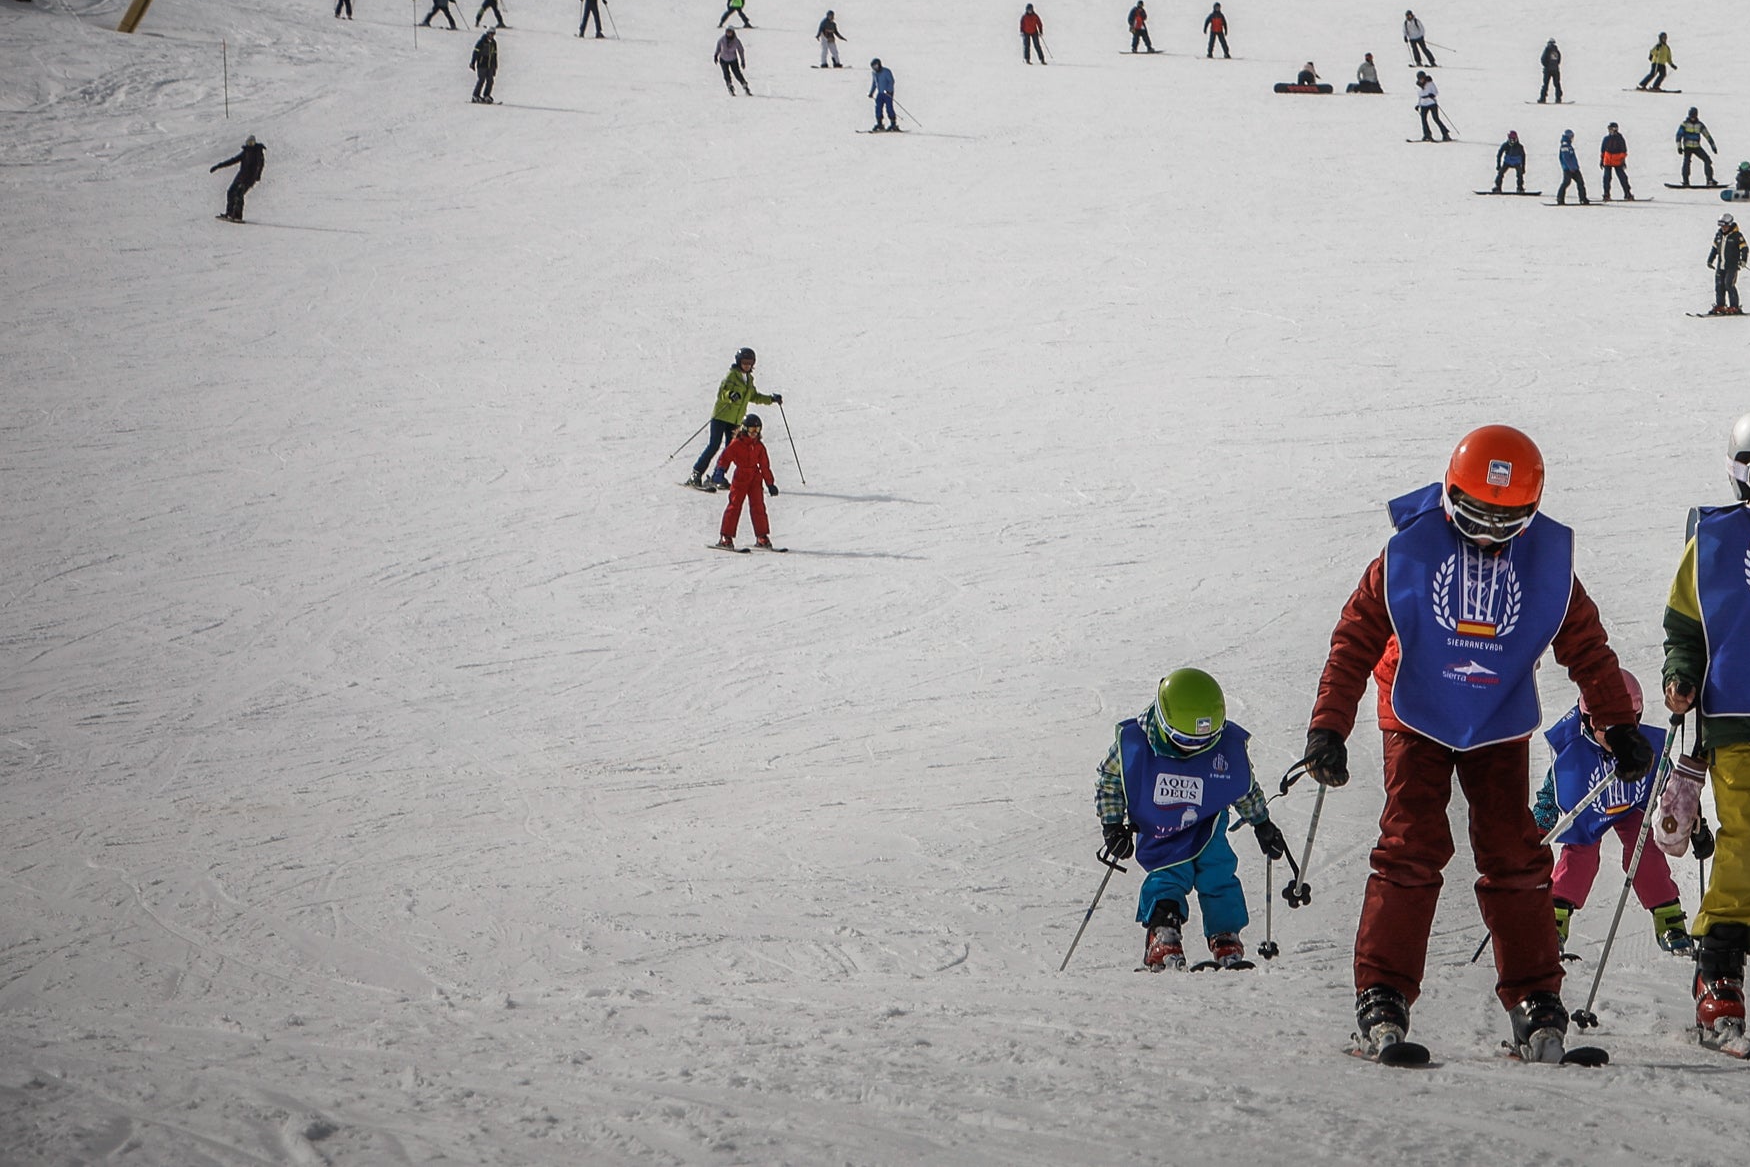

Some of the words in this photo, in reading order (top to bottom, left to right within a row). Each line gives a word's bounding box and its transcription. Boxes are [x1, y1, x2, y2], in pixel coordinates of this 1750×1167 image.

[1447, 638, 1503, 652] SIERRANEVADA
[1159, 777, 1199, 790] AQUA
[1160, 788, 1197, 800] DEUS
